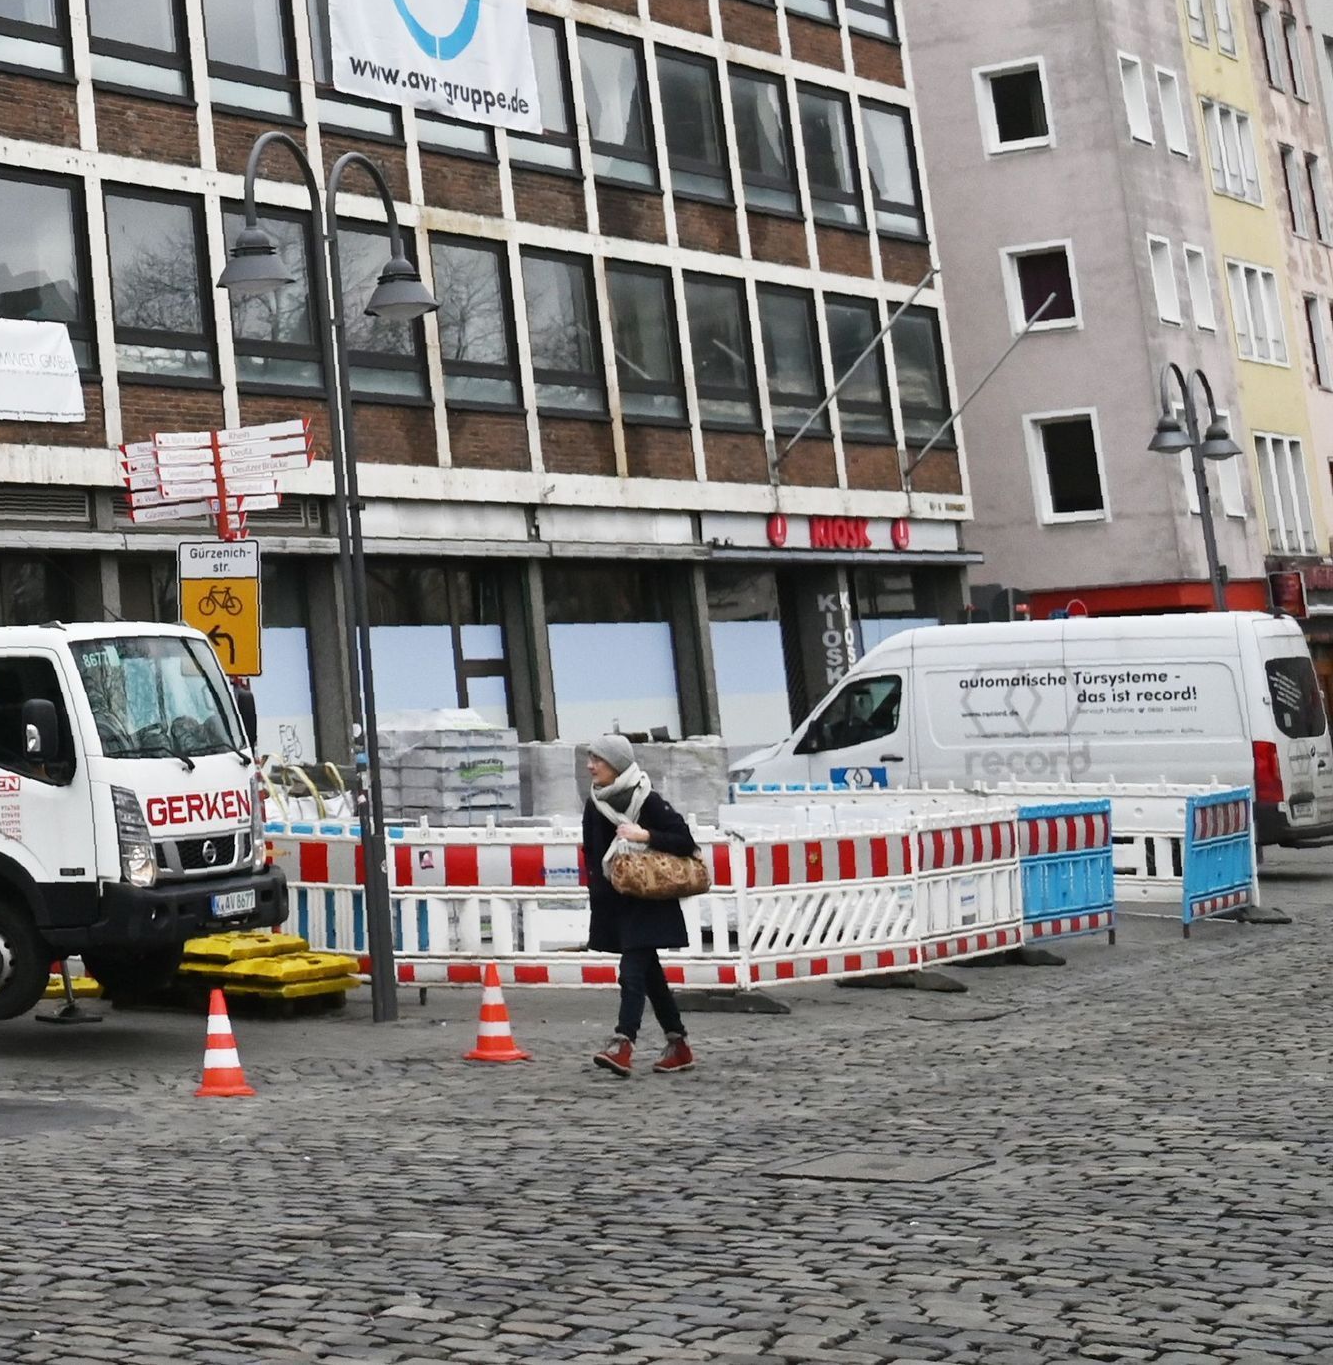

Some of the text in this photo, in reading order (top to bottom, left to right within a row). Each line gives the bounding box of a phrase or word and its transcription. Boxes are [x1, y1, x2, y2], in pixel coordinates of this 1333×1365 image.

[349, 56, 530, 115] www.avr-gruppe.de
[809, 516, 872, 549] KIOSK
[189, 546, 252, 560] Gürzenich-
[212, 561, 231, 573] str.
[959, 672, 1068, 690] automatische
[1072, 670, 1169, 688] Türsysteme
[1076, 686, 1198, 704] das ist record!
[963, 740, 1093, 775] record
[146, 789, 251, 827] GERKEN
